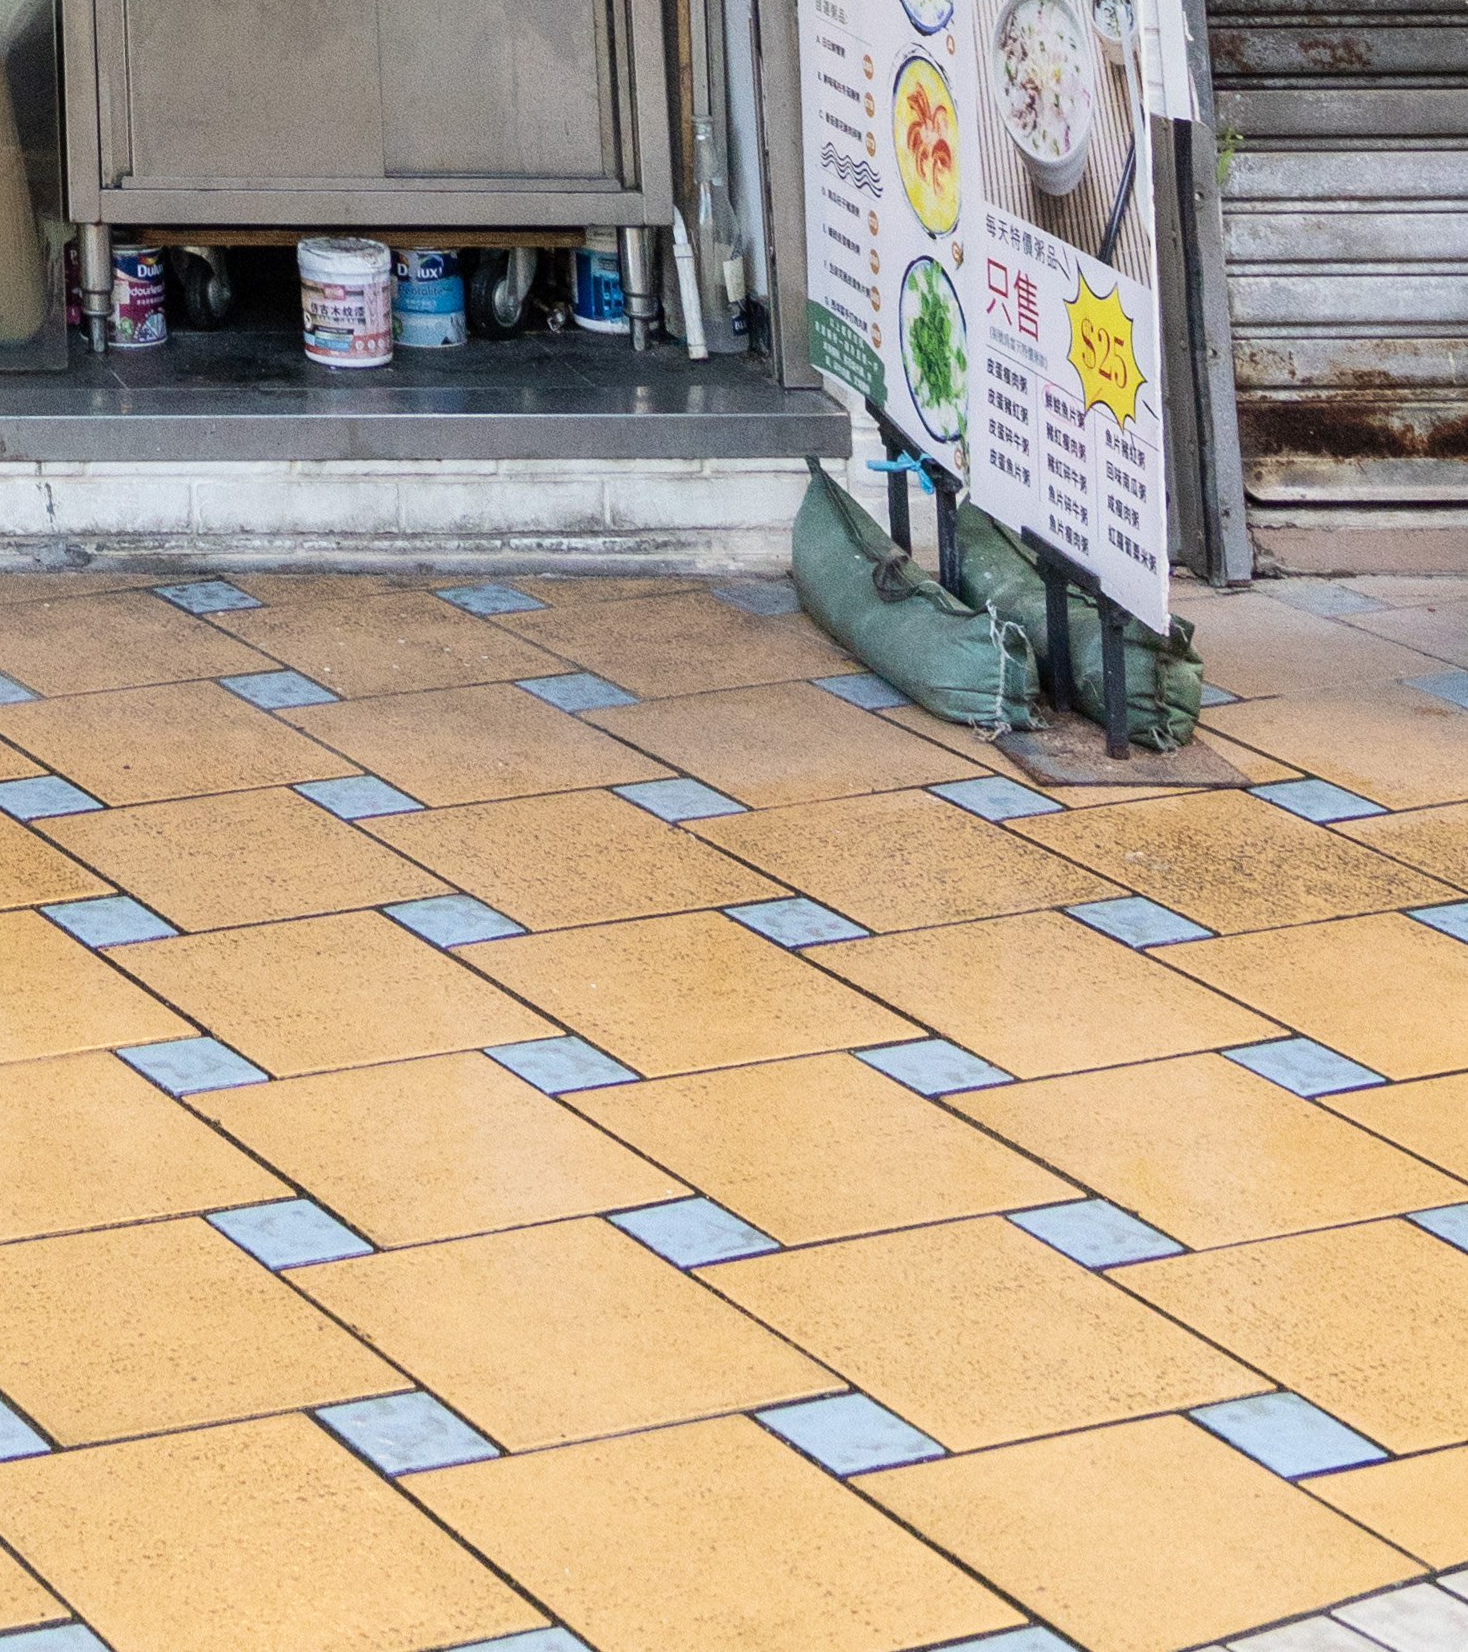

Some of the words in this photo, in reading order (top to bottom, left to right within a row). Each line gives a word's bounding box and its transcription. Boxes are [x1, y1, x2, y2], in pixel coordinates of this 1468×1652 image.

[398, 264, 438, 278] Dlux
[986, 214, 1058, 271] 每天特價粥品
[987, 258, 1039, 342] 只售
[1081, 318, 1127, 389] $25
